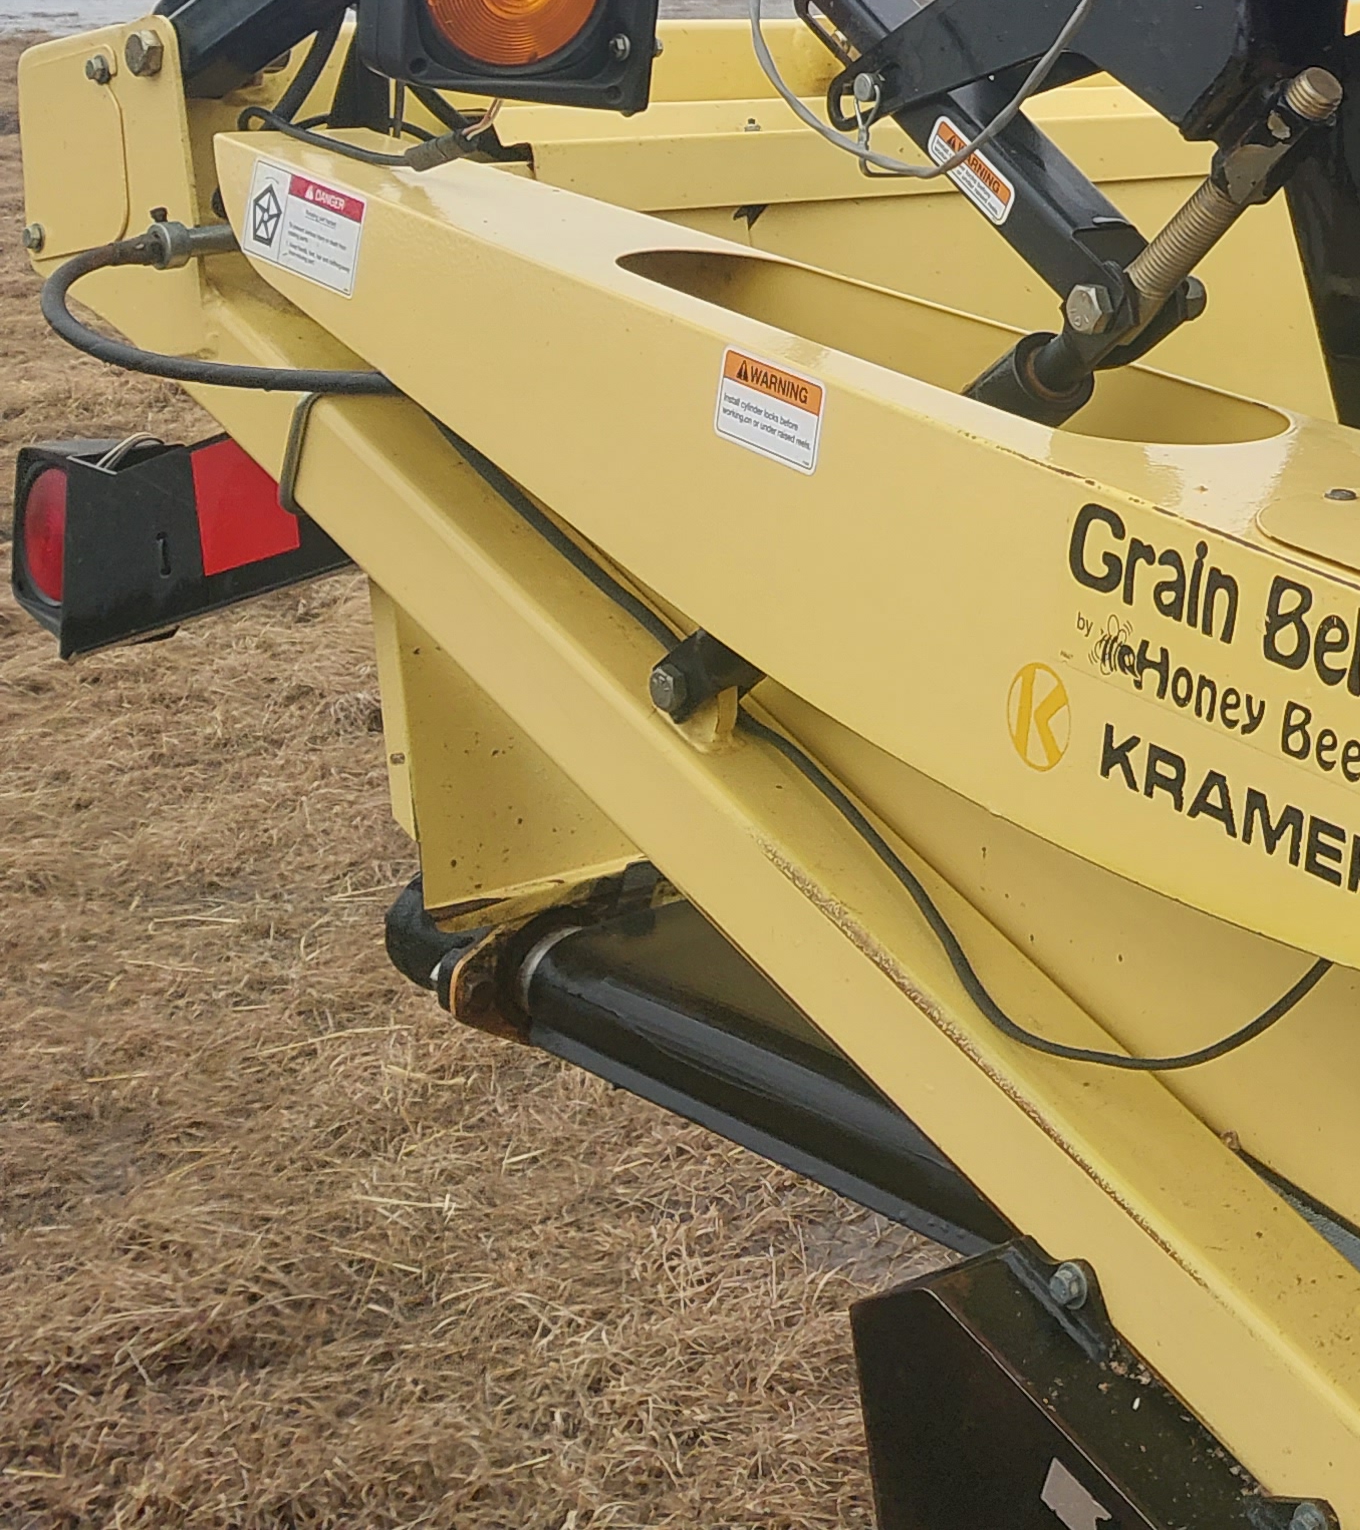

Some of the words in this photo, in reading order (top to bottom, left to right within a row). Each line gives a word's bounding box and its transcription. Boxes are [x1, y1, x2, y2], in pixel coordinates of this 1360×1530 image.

[315, 189, 345, 211] DANGER
[750, 365, 808, 405] WARNING
[1069, 503, 1239, 645] Grain
[1076, 611, 1094, 638] by
[1133, 638, 1266, 736] Honey
